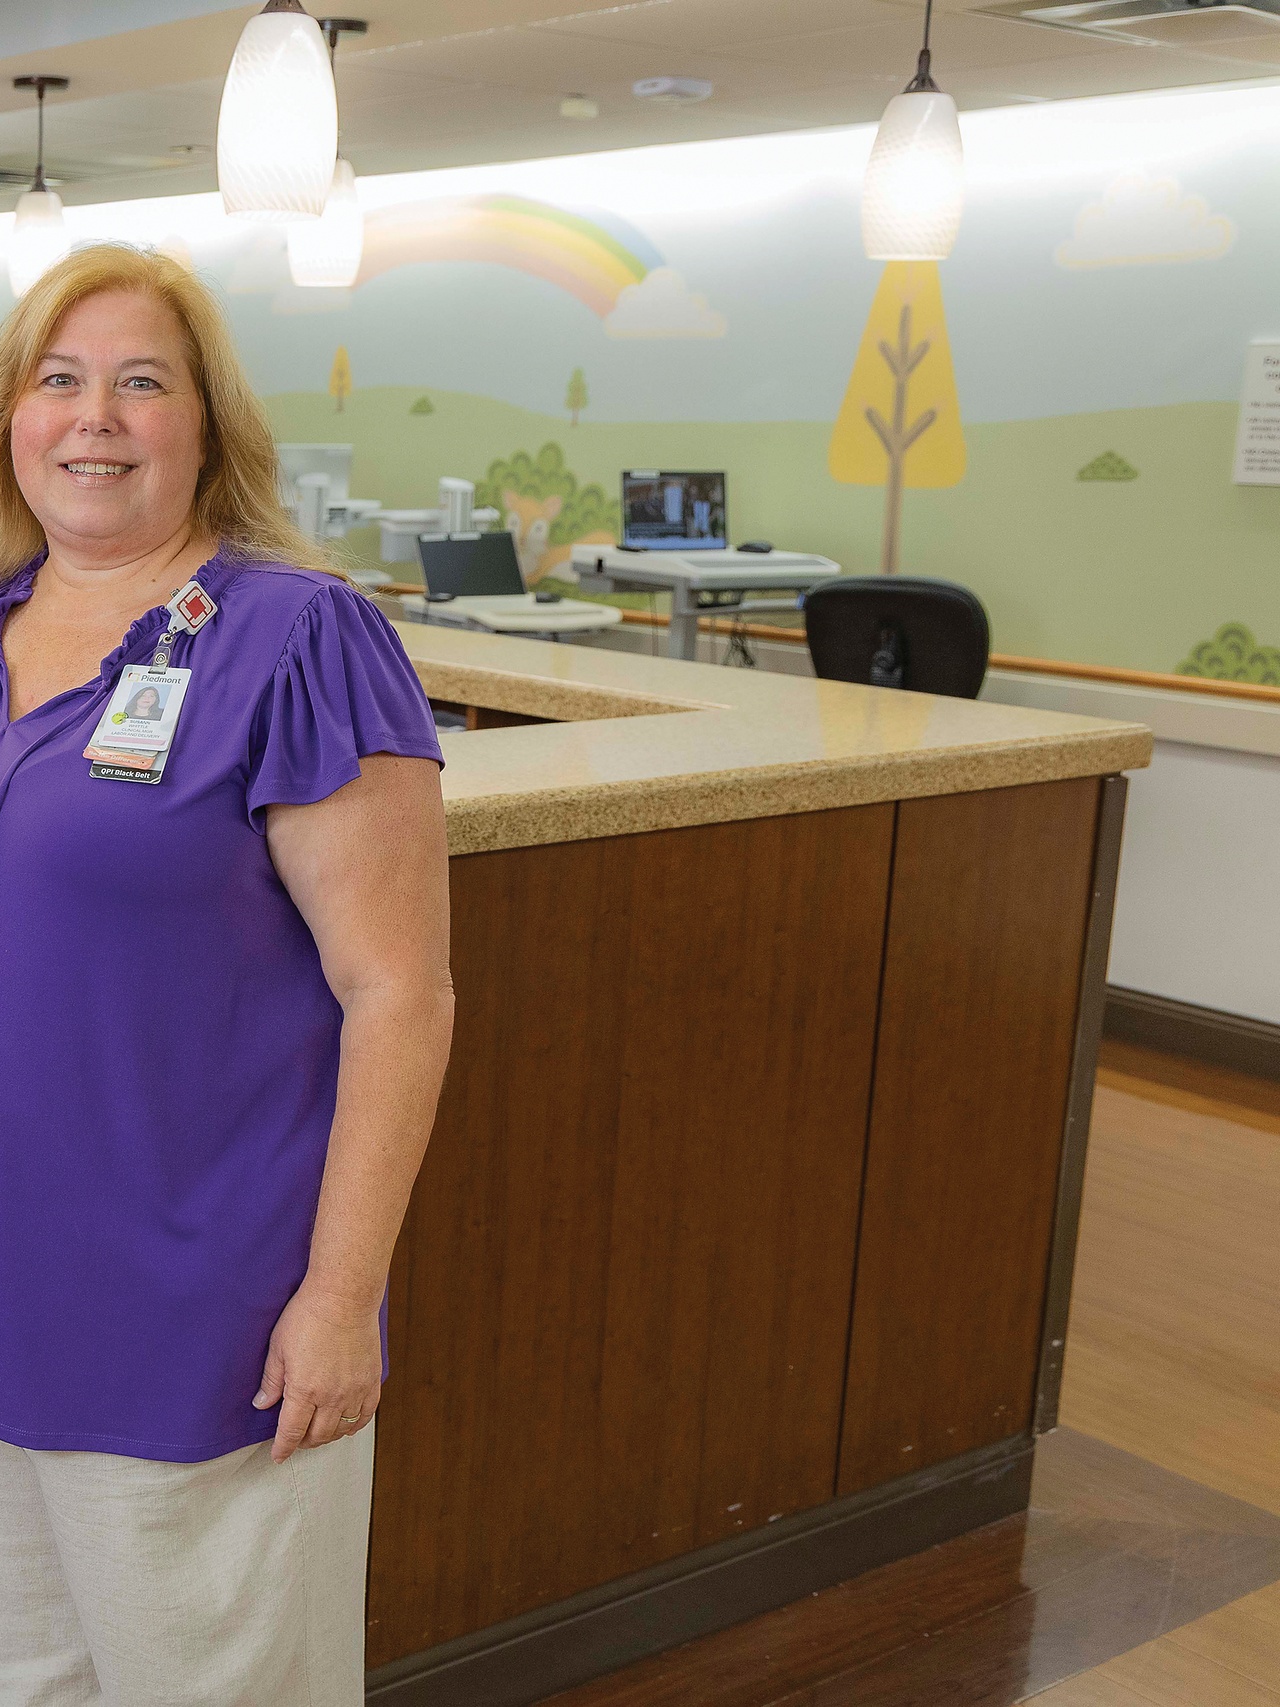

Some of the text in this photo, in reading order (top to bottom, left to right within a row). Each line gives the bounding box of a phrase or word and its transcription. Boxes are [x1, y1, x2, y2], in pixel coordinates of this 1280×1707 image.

[141, 674, 182, 684] Piedmont
[114, 769, 134, 777] Black
[135, 771, 151, 779] Belt
